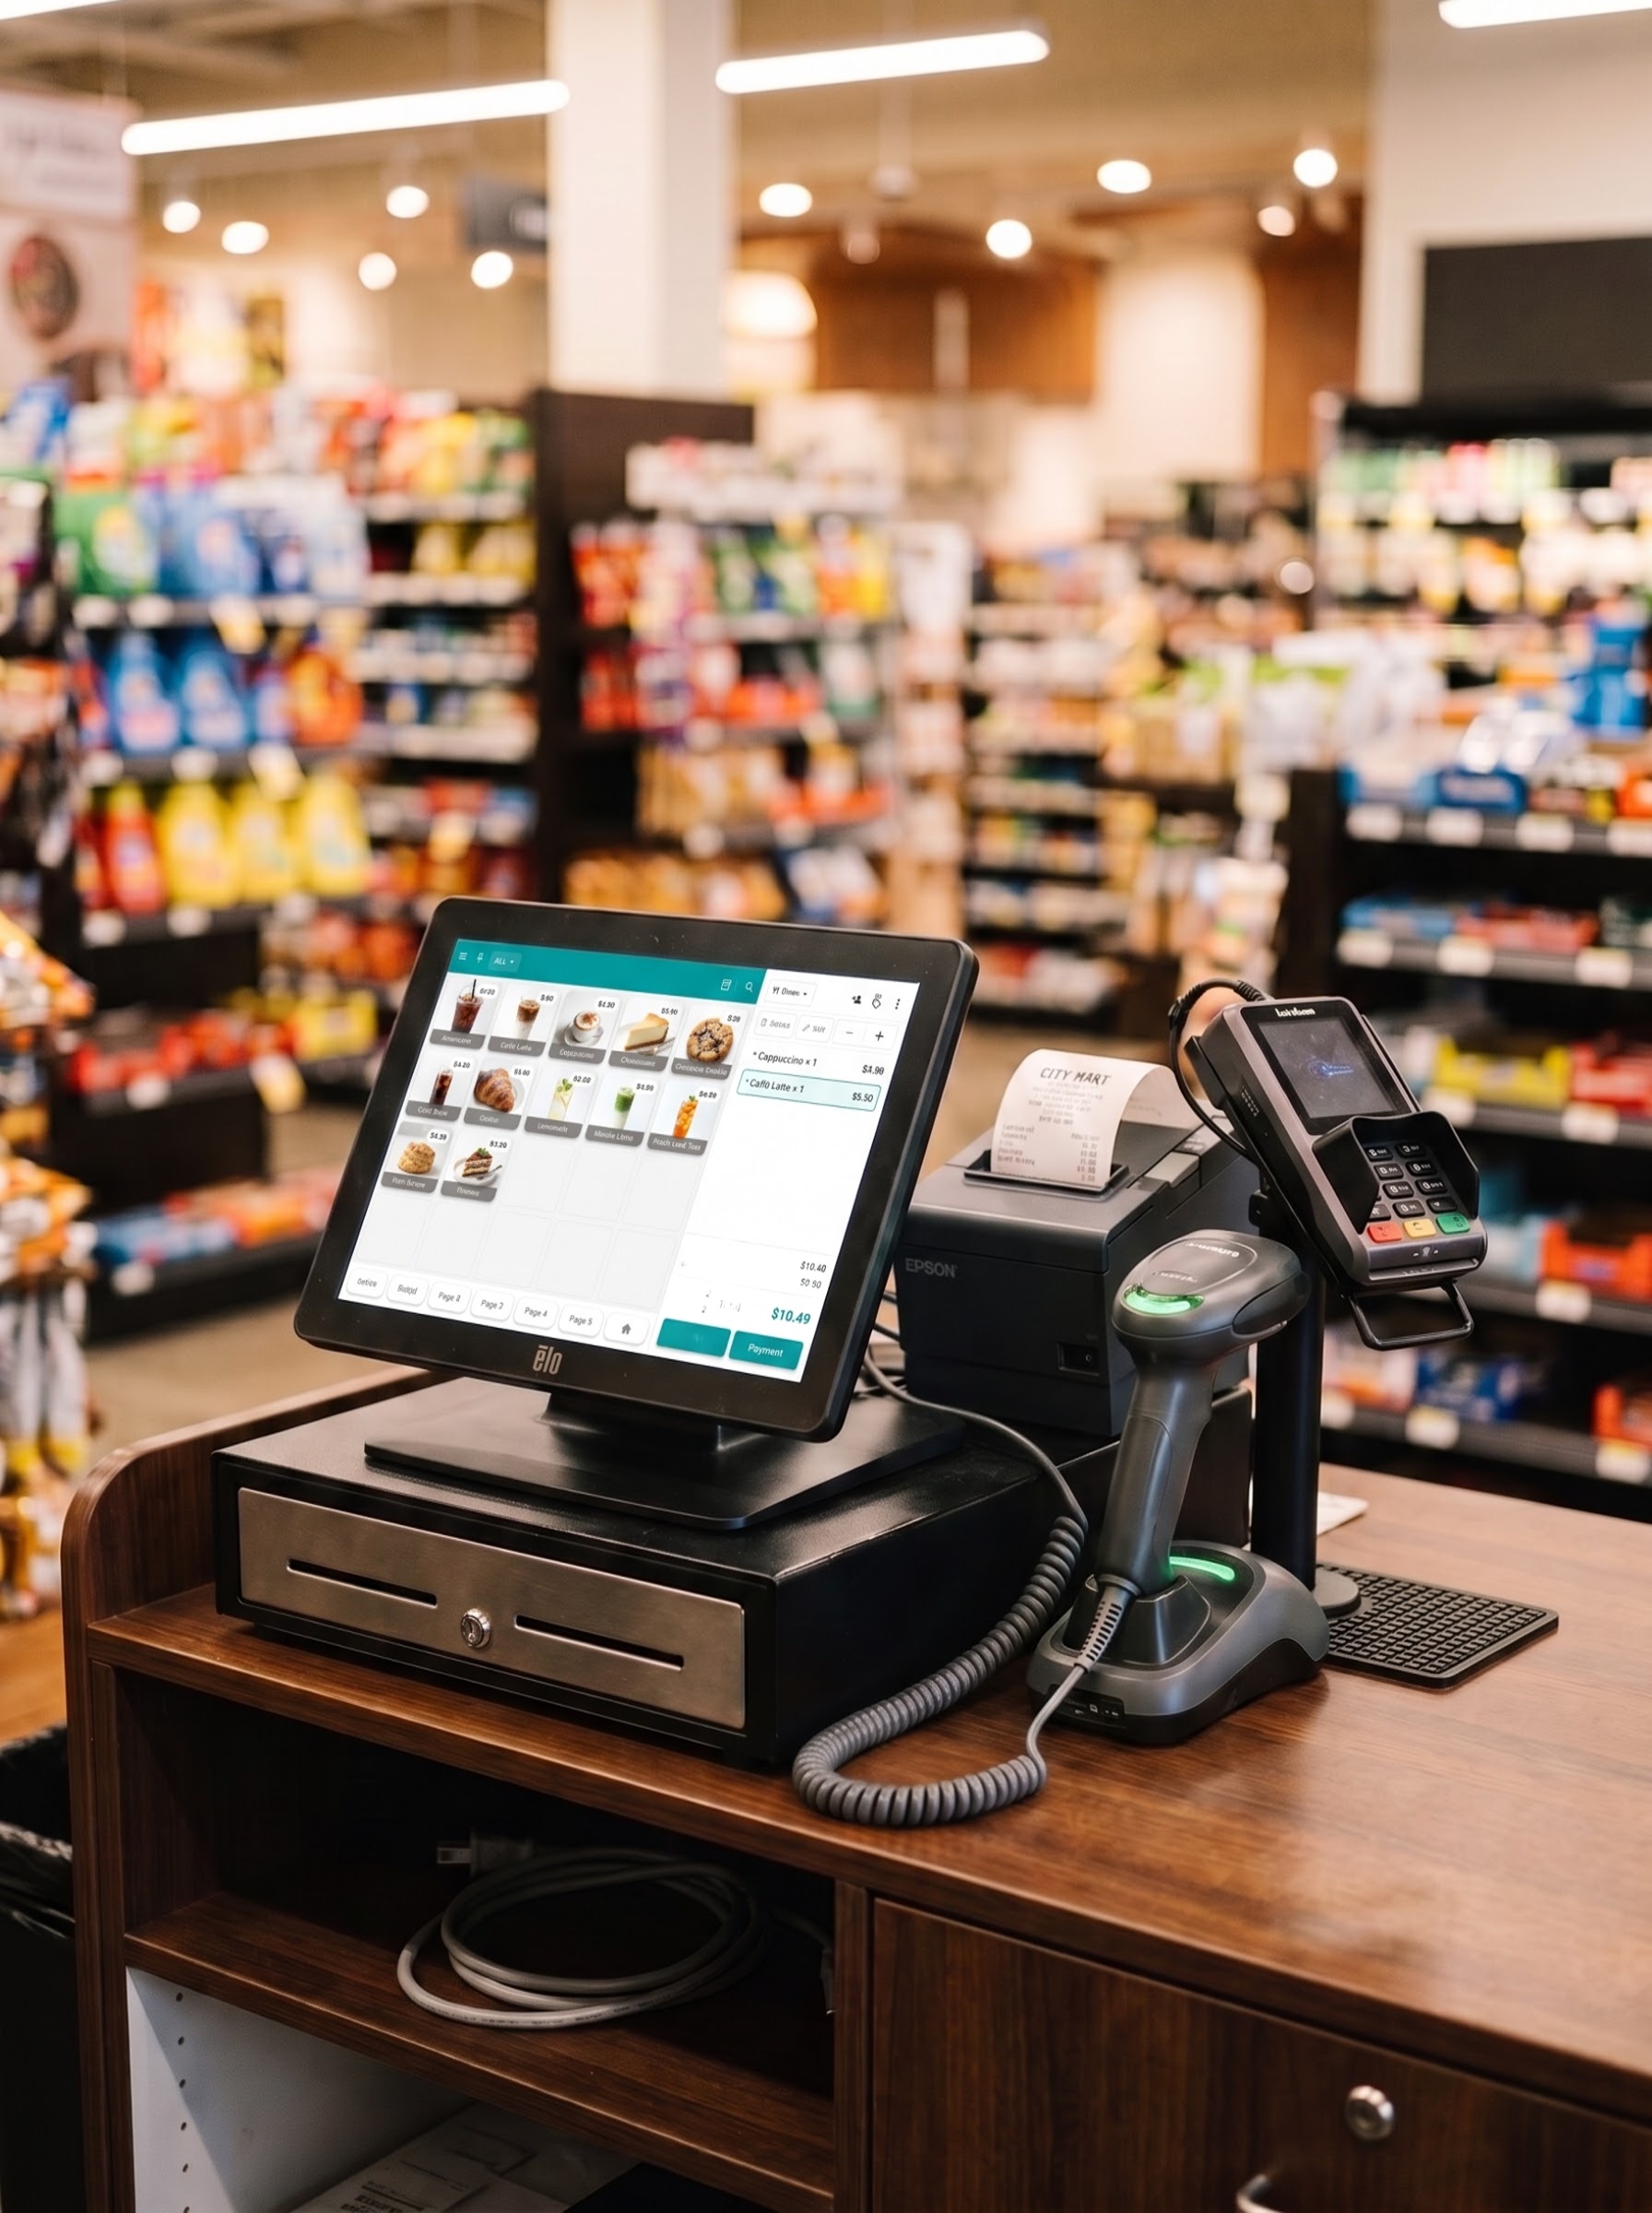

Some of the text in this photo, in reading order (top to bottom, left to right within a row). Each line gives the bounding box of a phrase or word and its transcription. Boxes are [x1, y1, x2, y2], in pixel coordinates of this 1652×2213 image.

[493, 956, 507, 966] ALL
[758, 1051, 804, 1066] Cappuccino
[1039, 1067, 1073, 1081] CITY
[1073, 1071, 1113, 1086] MART
[771, 1082, 791, 1093] Latte
[852, 1092, 874, 1104] $5.50
[904, 1257, 956, 1279] EPSON
[438, 1291, 455, 1303] Page
[480, 1299, 498, 1310] Page
[524, 1307, 542, 1318] Page
[771, 1307, 811, 1325] $10.49
[569, 1314, 587, 1326] Page
[748, 1343, 784, 1357] Payment
